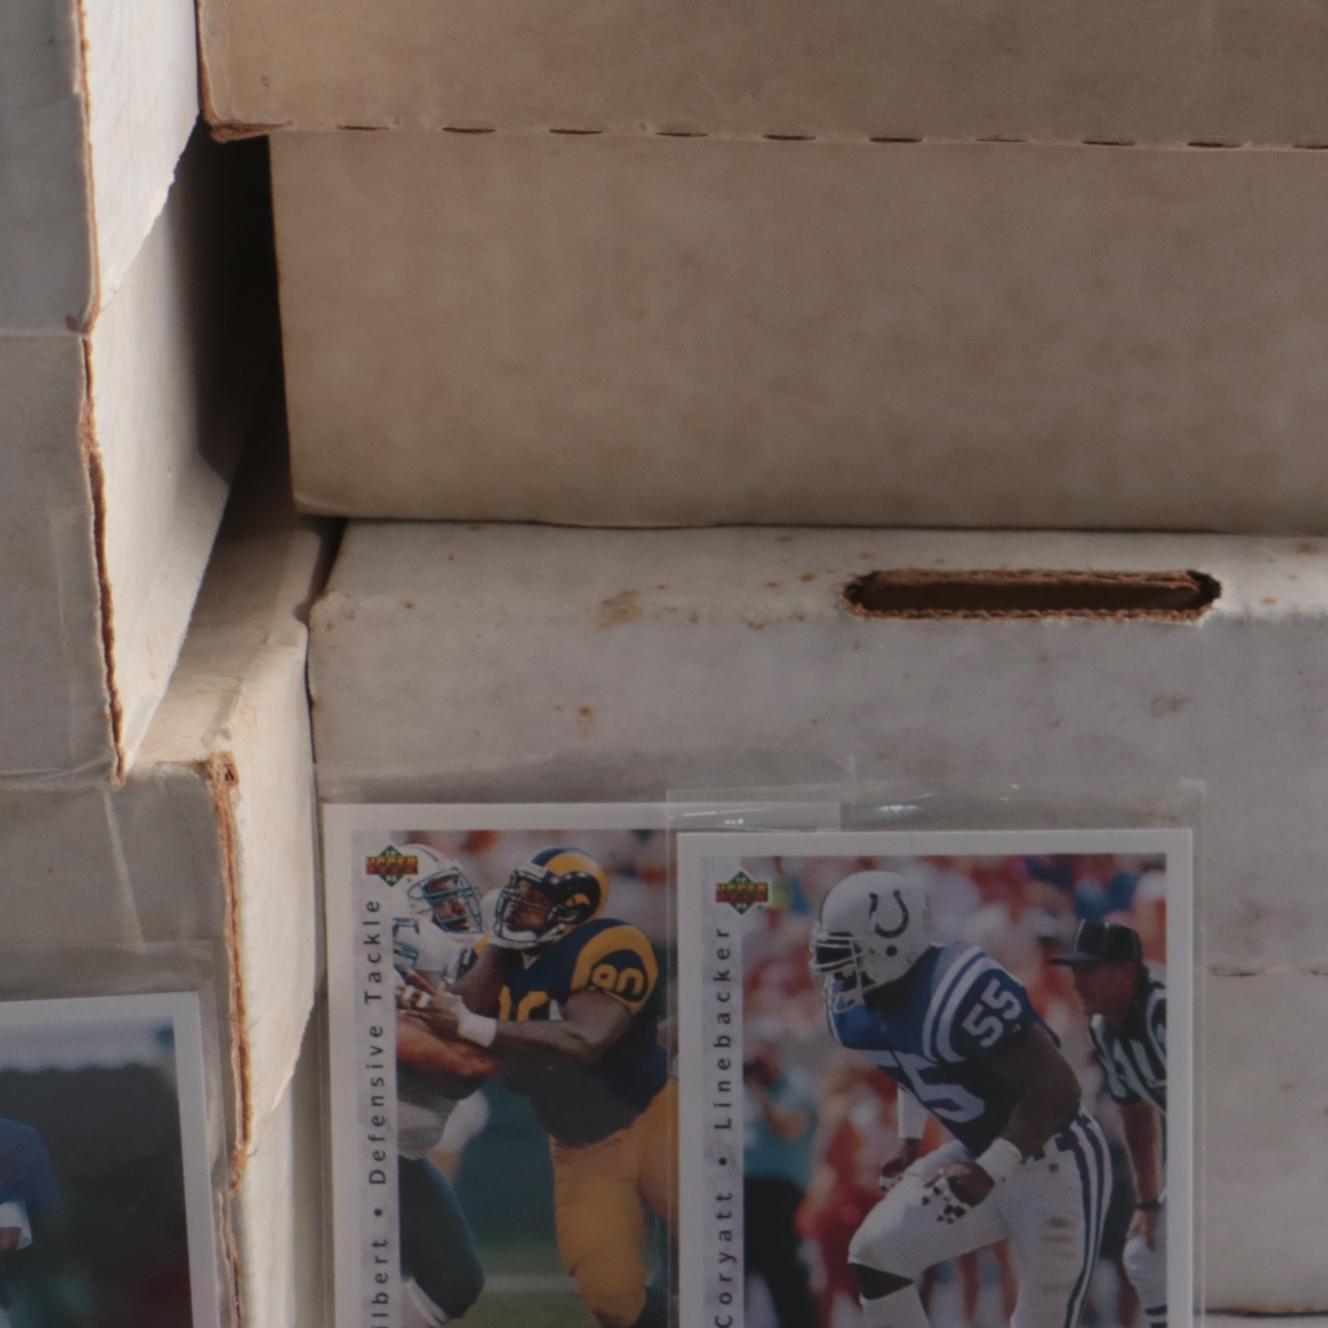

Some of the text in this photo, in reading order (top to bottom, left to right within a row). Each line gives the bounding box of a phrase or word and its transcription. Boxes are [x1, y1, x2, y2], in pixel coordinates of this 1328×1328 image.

[363, 900, 382, 1005] Tackle
[961, 977, 1023, 1049] 55
[366, 1025, 388, 1185] Defensive
[713, 928, 738, 1328] Coryatt Linebacker
